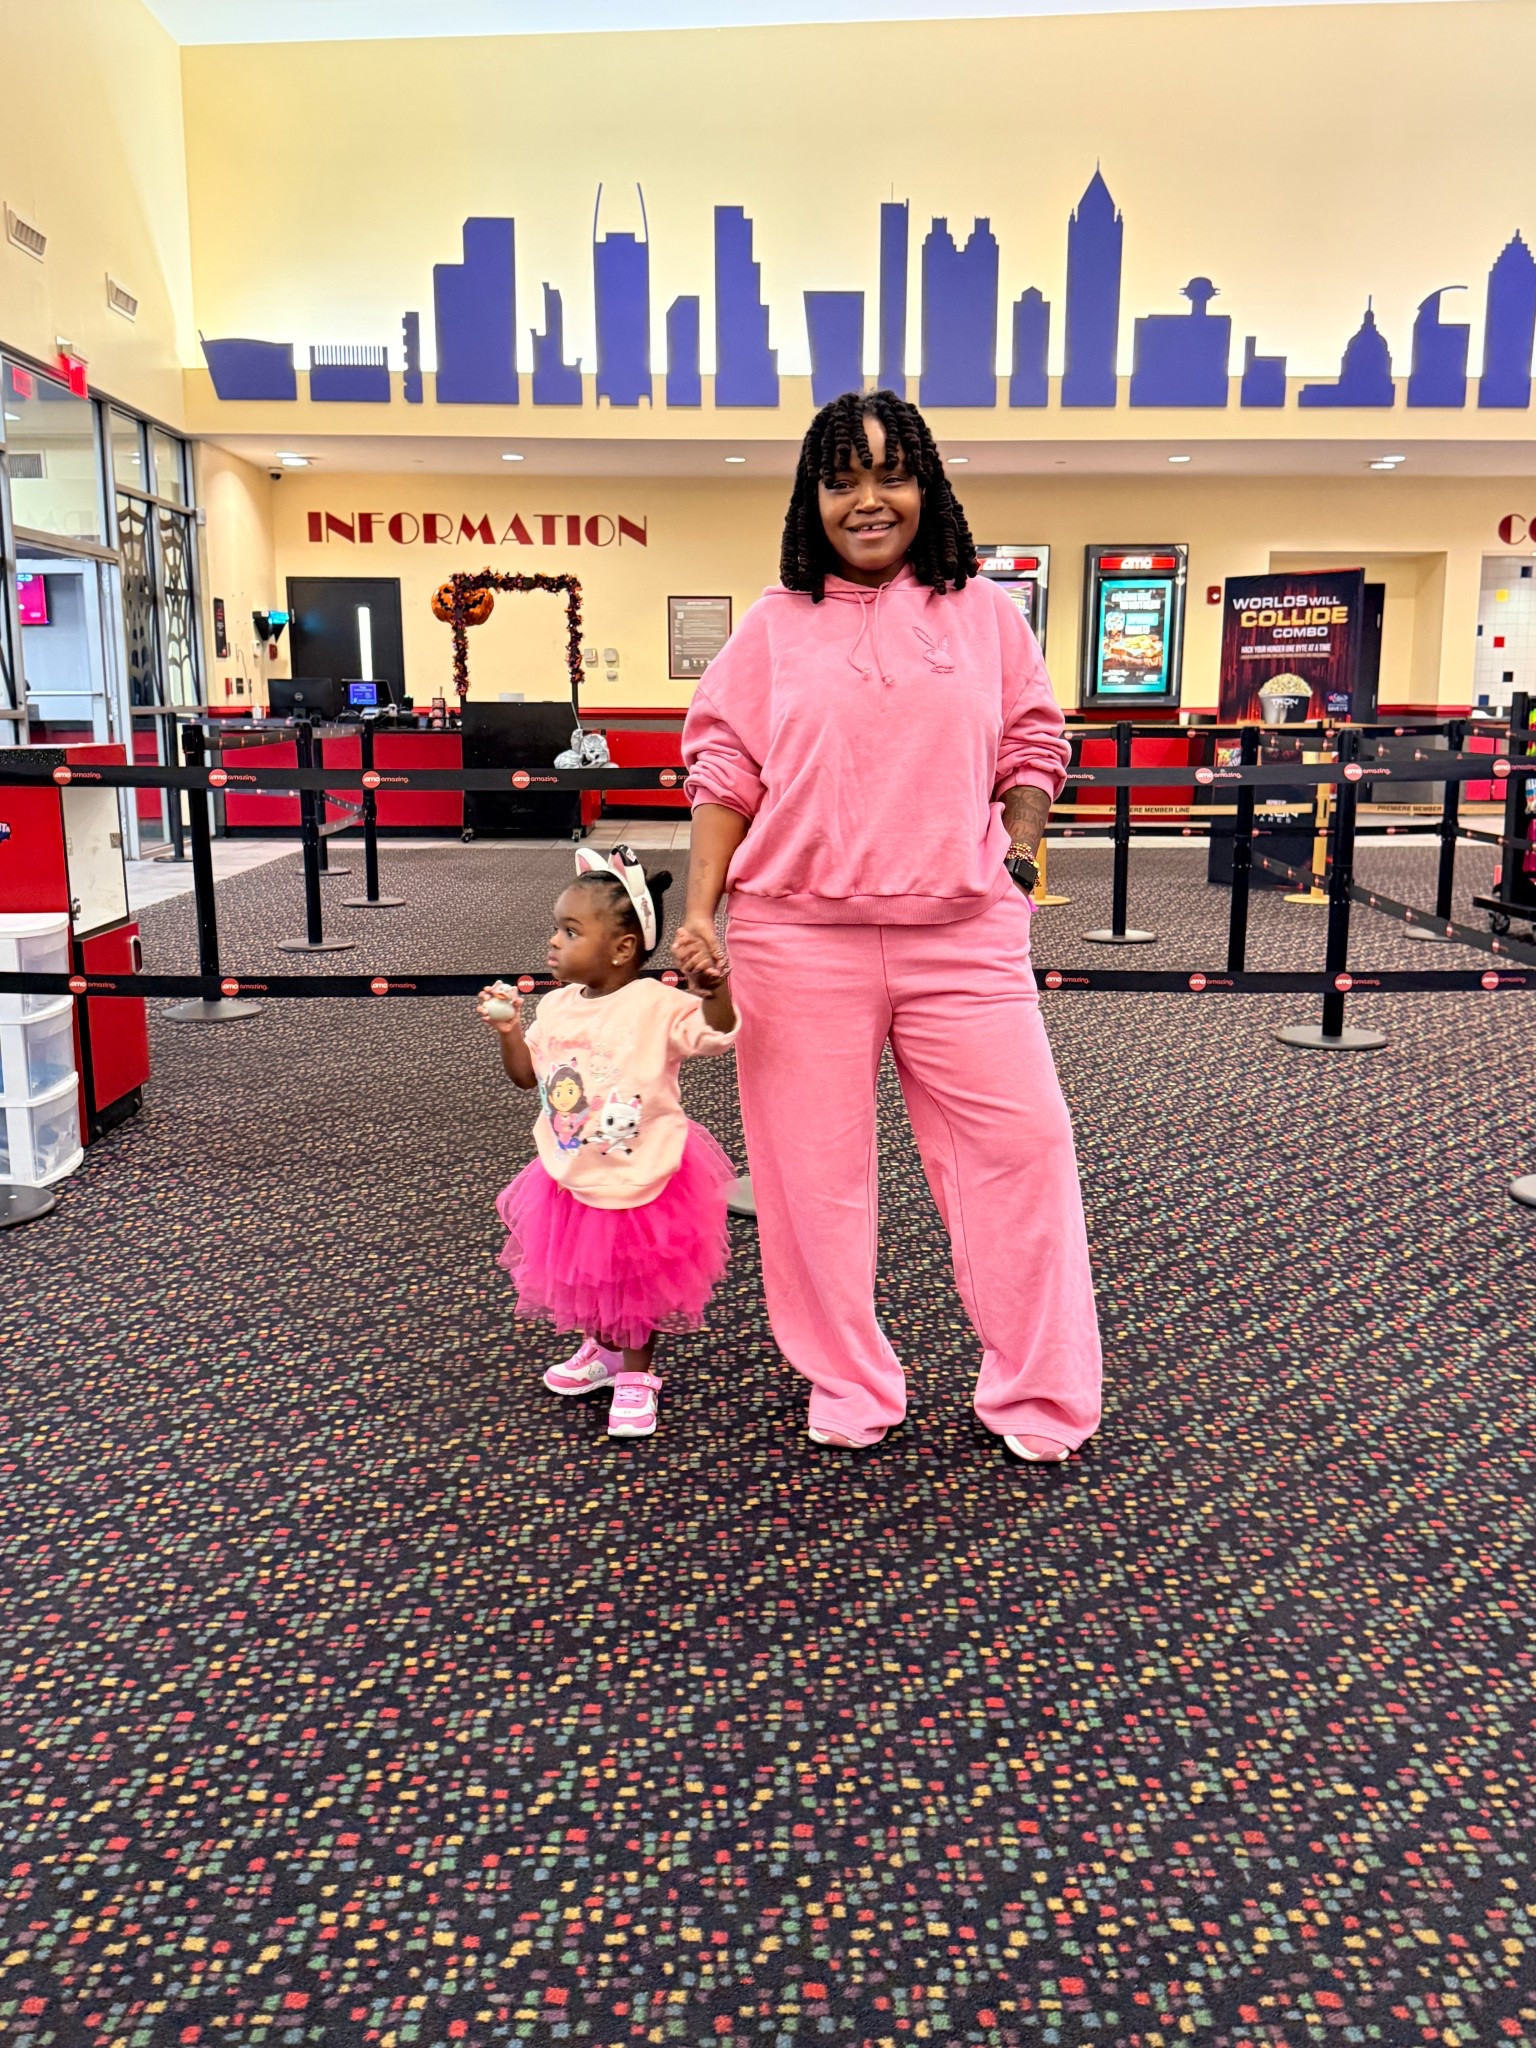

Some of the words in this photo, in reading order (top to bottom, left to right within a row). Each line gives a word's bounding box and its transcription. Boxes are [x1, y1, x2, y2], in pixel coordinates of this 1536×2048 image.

[307, 511, 648, 547] INFORMATION
[1498, 513, 1536, 545] C
[1232, 595, 1308, 610] WORLDS
[1309, 596, 1340, 606] WILL
[1240, 606, 1348, 628] COLLIDE
[1272, 626, 1328, 638] COMBO
